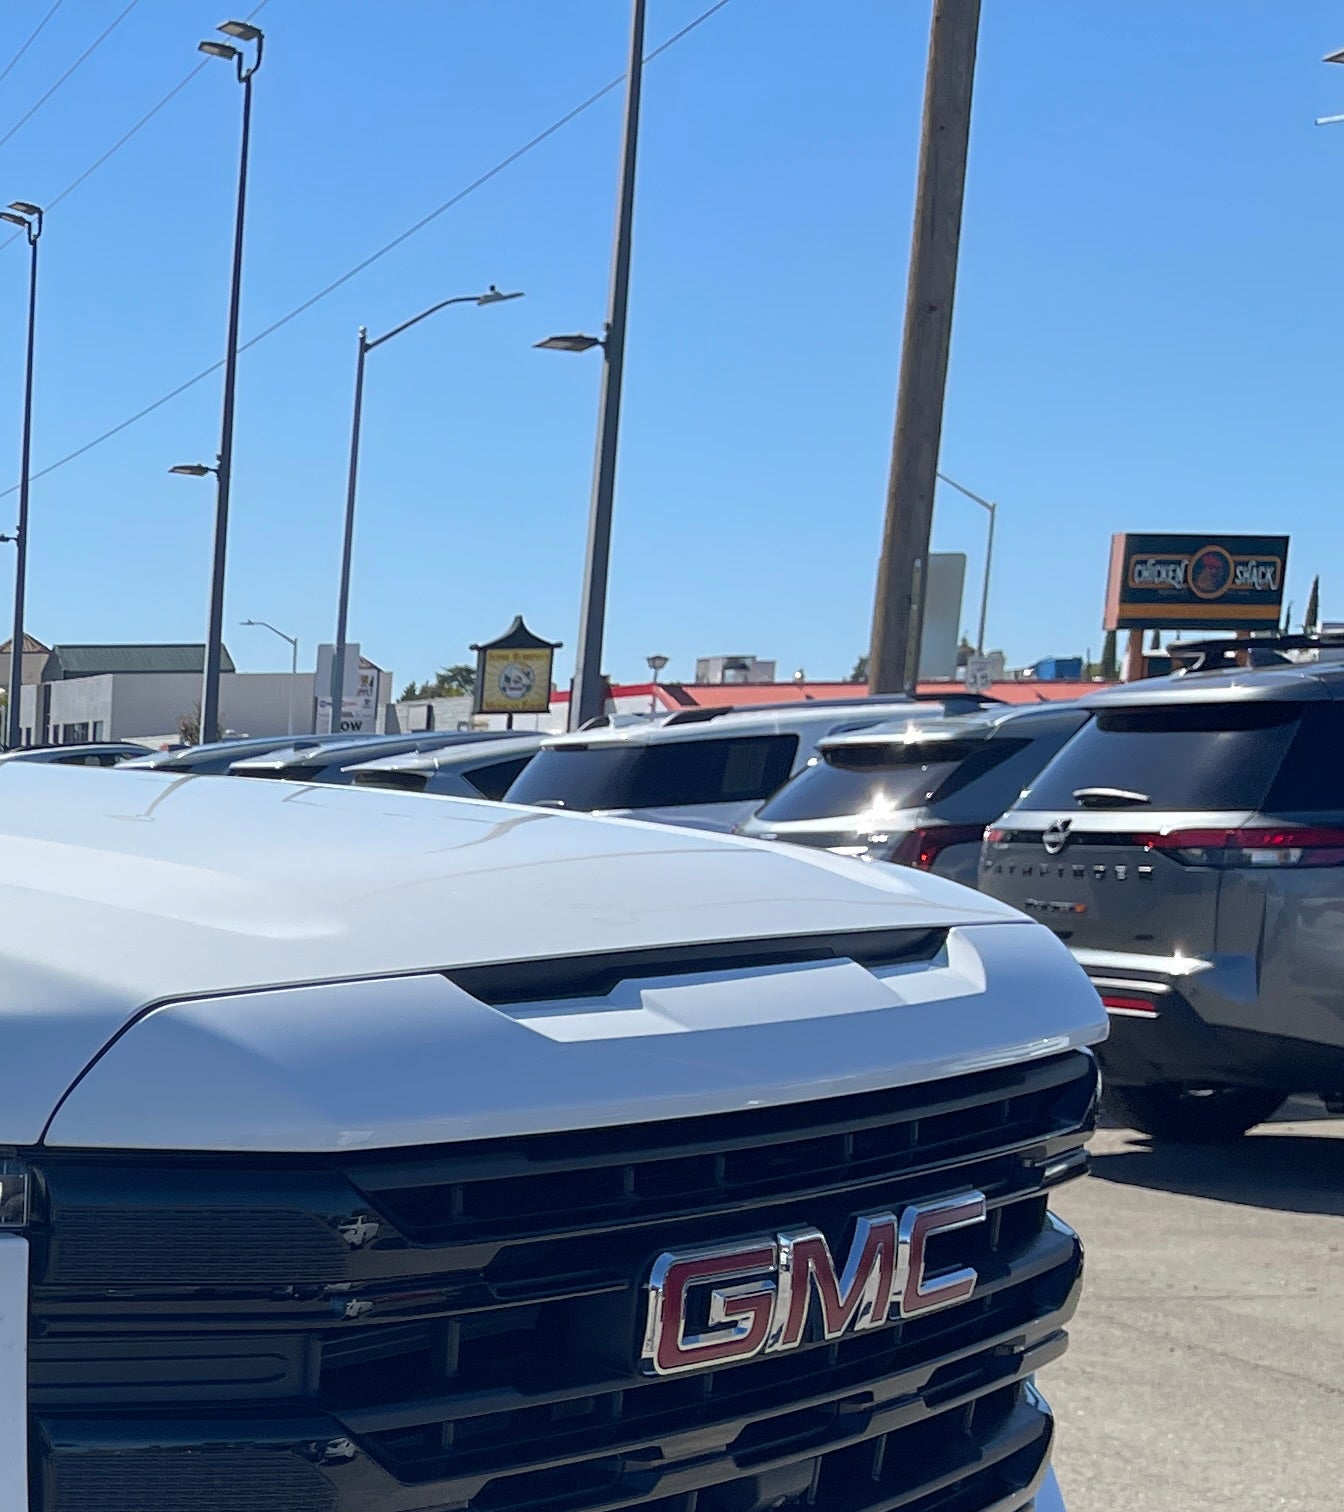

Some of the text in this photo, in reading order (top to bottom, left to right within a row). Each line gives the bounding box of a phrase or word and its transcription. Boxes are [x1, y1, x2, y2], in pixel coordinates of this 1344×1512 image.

[1134, 559, 1279, 590] CHICKEN SHACK
[339, 720, 362, 732] OW
[641, 1189, 986, 1376] GMC
